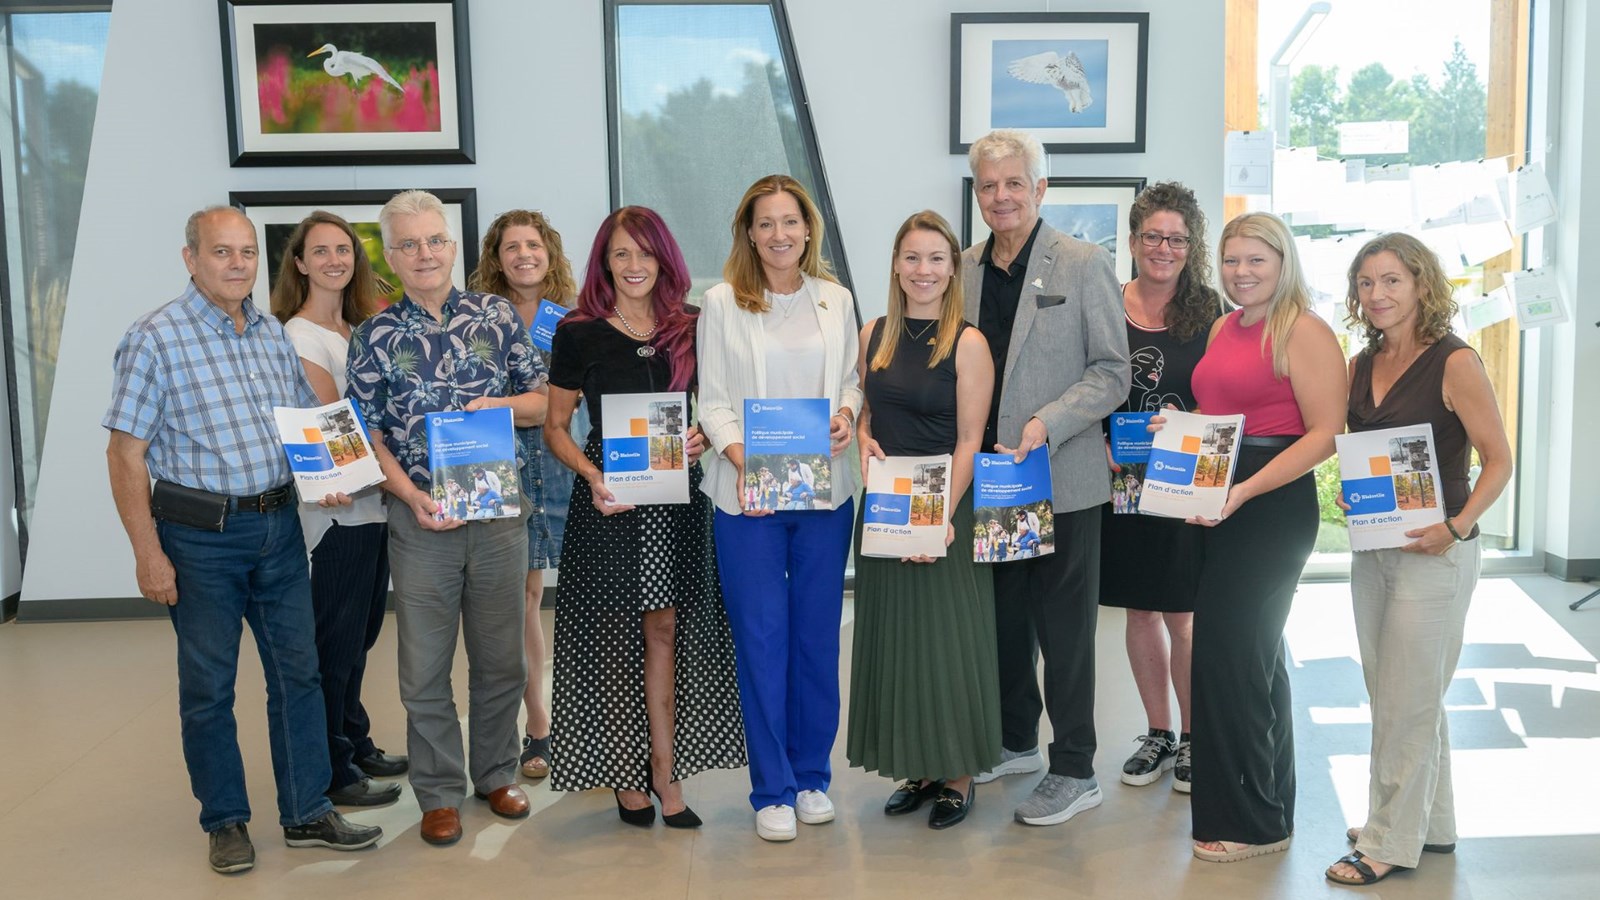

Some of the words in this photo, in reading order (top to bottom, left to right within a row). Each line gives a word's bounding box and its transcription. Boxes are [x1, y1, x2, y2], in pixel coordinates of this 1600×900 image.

[1165, 464, 1186, 472] Blainville
[624, 474, 654, 482] d'action
[1147, 483, 1163, 491] Plan
[1164, 487, 1194, 496] d'action
[1352, 518, 1369, 526] Plan
[1370, 515, 1403, 524] d'action
[882, 527, 912, 535] d'action
